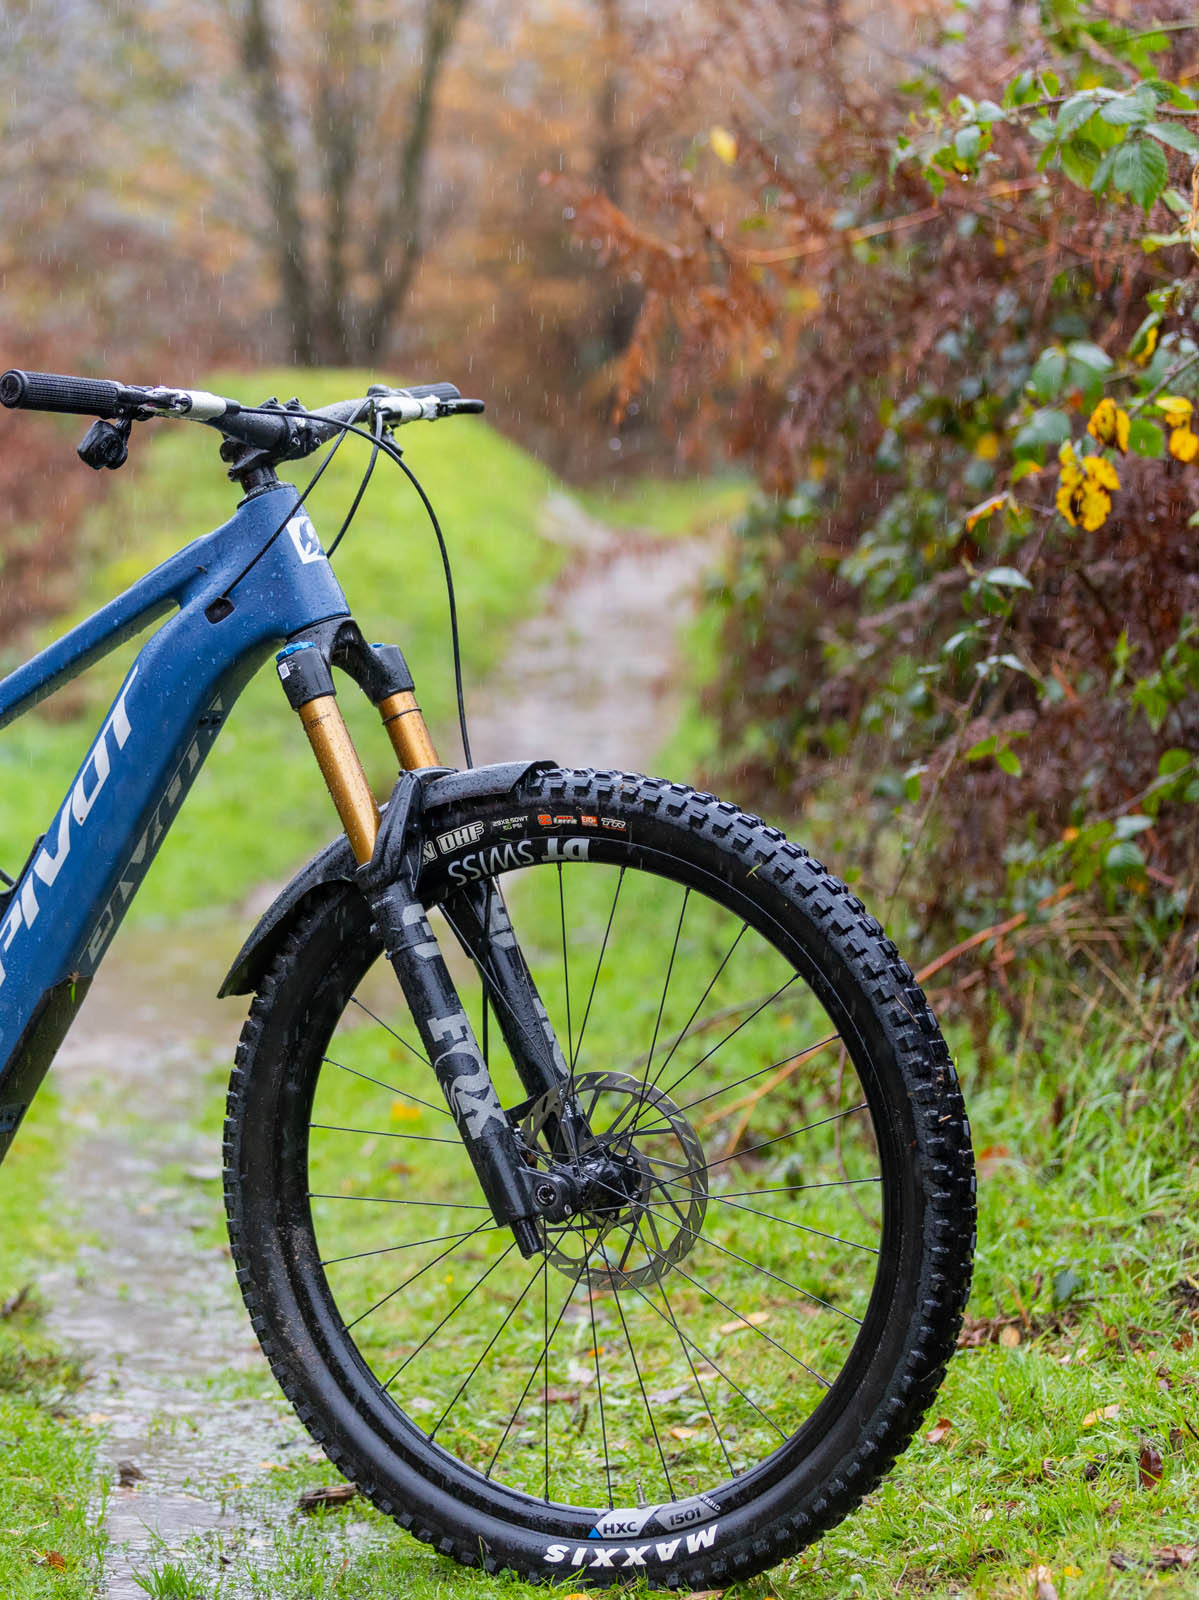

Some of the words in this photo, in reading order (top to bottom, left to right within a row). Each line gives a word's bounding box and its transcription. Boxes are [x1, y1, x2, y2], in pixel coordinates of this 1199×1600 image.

[436, 820, 485, 854] DHF
[541, 838, 590, 862] DT
[448, 840, 534, 887] SWISS
[427, 1008, 509, 1140] FOX
[602, 1521, 638, 1535] HXC
[669, 1507, 702, 1526] 1501
[543, 1524, 719, 1568] MAXXIS
